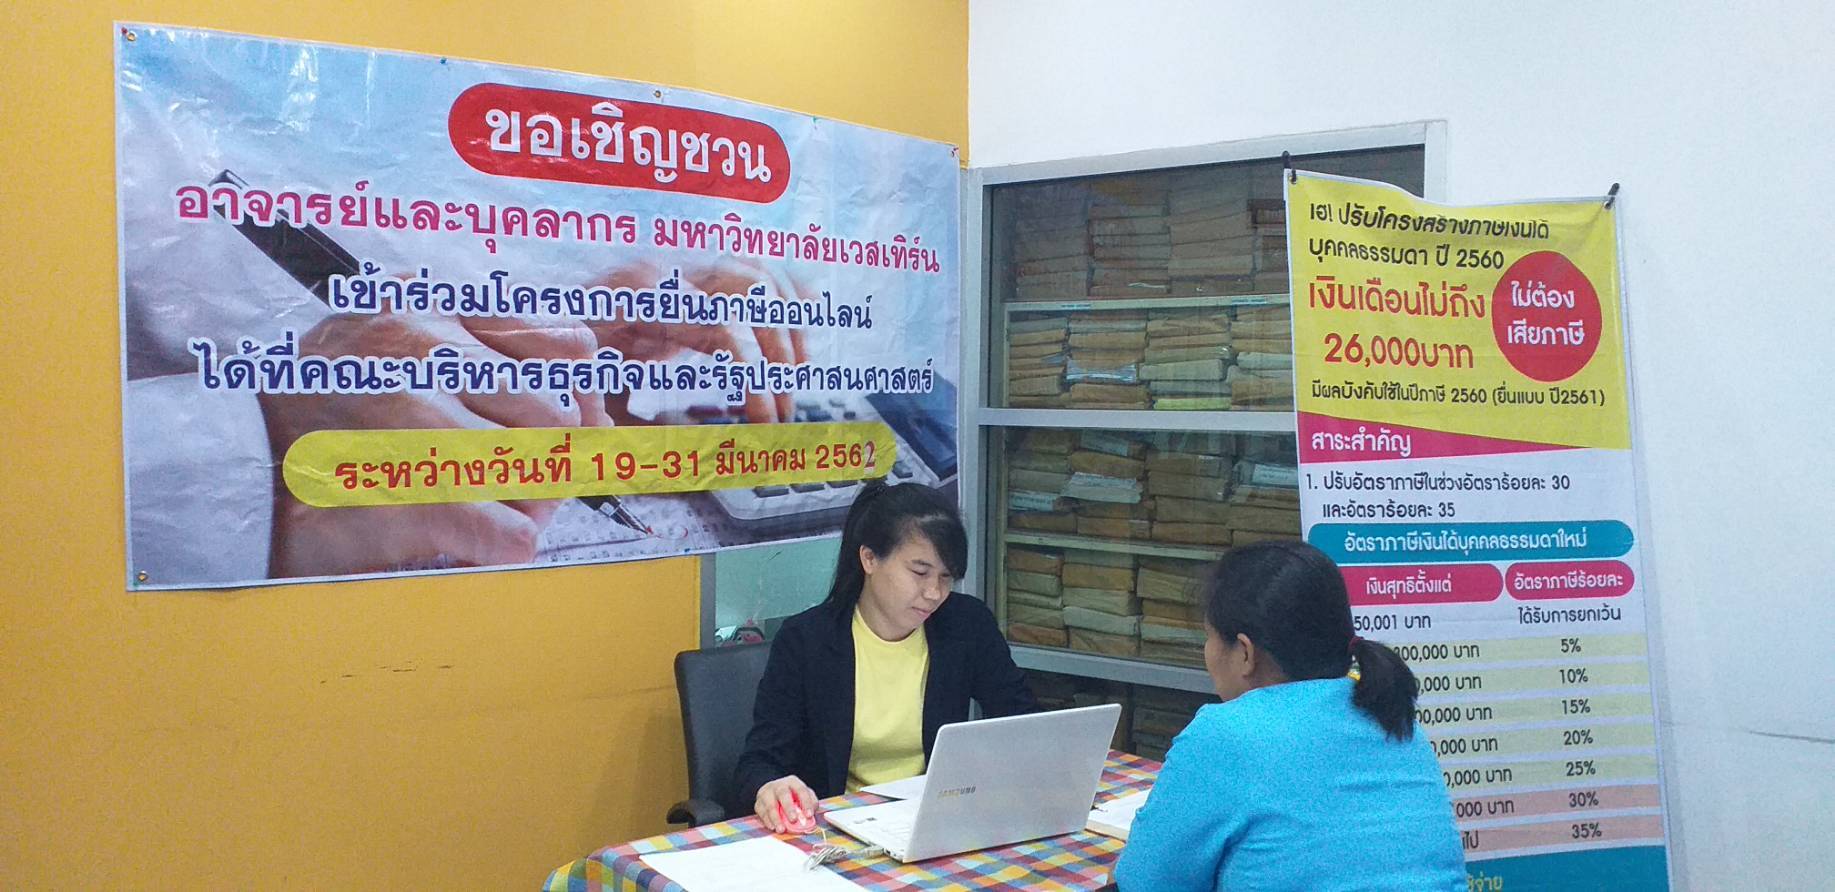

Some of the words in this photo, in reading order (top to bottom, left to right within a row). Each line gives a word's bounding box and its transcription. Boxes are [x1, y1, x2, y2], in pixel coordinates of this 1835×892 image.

[485, 101, 772, 183] ขอเชิญชวน
[1310, 202, 1333, 223] เฮ!
[175, 180, 636, 254] อาจารย์และบุคลากร
[654, 212, 940, 274] มหาวิทยาลัยเวสเทิร์น
[1309, 236, 1428, 266] บุคคลธรรมดา
[1436, 243, 1450, 267] ปี
[1456, 249, 1505, 270] 2560
[333, 260, 873, 329] เข้าร่วมโครงการยื่นภาษีออนไลน์
[1309, 275, 1486, 319] เงินเดือนไม่ถึง
[1511, 280, 1575, 309] ไม่ต้อง
[1507, 320, 1585, 347] เสียภาษี
[1324, 332, 1474, 369] 26,000บาท
[193, 331, 934, 407] ได้ที่คณะบริหารธุรกิจและรัฐประศาสนศาสตร์
[1311, 380, 1446, 403] มีผลบังคับใช้ในปีภาษี
[1451, 388, 1487, 404] 2560
[1492, 386, 1545, 407] (ยื่นแบบ
[1549, 387, 1605, 407] ปี2561)
[1311, 426, 1412, 457] สาระสำคัญ
[335, 433, 572, 490] ระหว่างวันที่
[591, 449, 700, 482] 19-31
[715, 438, 806, 475] มีนาคม
[815, 440, 876, 470] 2562
[1306, 473, 1318, 491] 1.
[1323, 470, 1546, 492] ปรับอัตราภาษีในช่วงอัตราร้อยละ
[1551, 474, 1571, 491] 30
[1322, 498, 1433, 518] และอัตราร้อยละ
[1438, 502, 1456, 518] 35
[1344, 526, 1588, 556] อัตราภาษีเงินได้บุคคลธรรมดาใหม่
[1365, 568, 1452, 600] เงินสุทธิตั้งแต่
[1513, 569, 1623, 591] อัตราภาษีร้อยละ
[1404, 614, 1431, 630] บาท
[1518, 603, 1621, 625] ได้รับการยกเว้น
[1453, 644, 1480, 660] บาท
[1560, 638, 1581, 653] 5%
[1455, 675, 1482, 691] บาท
[1559, 667, 1588, 684] 10%
[1466, 706, 1493, 722] บาท
[1562, 698, 1591, 714] 15%
[1471, 736, 1498, 752] บาท
[1563, 729, 1593, 745] 20%
[1485, 767, 1512, 783] บาท
[1566, 760, 1596, 776] 25%
[1487, 799, 1514, 815] บาท
[1568, 791, 1599, 808] 30%
[1462, 830, 1479, 850] ไป
[1571, 823, 1602, 839] 35%
